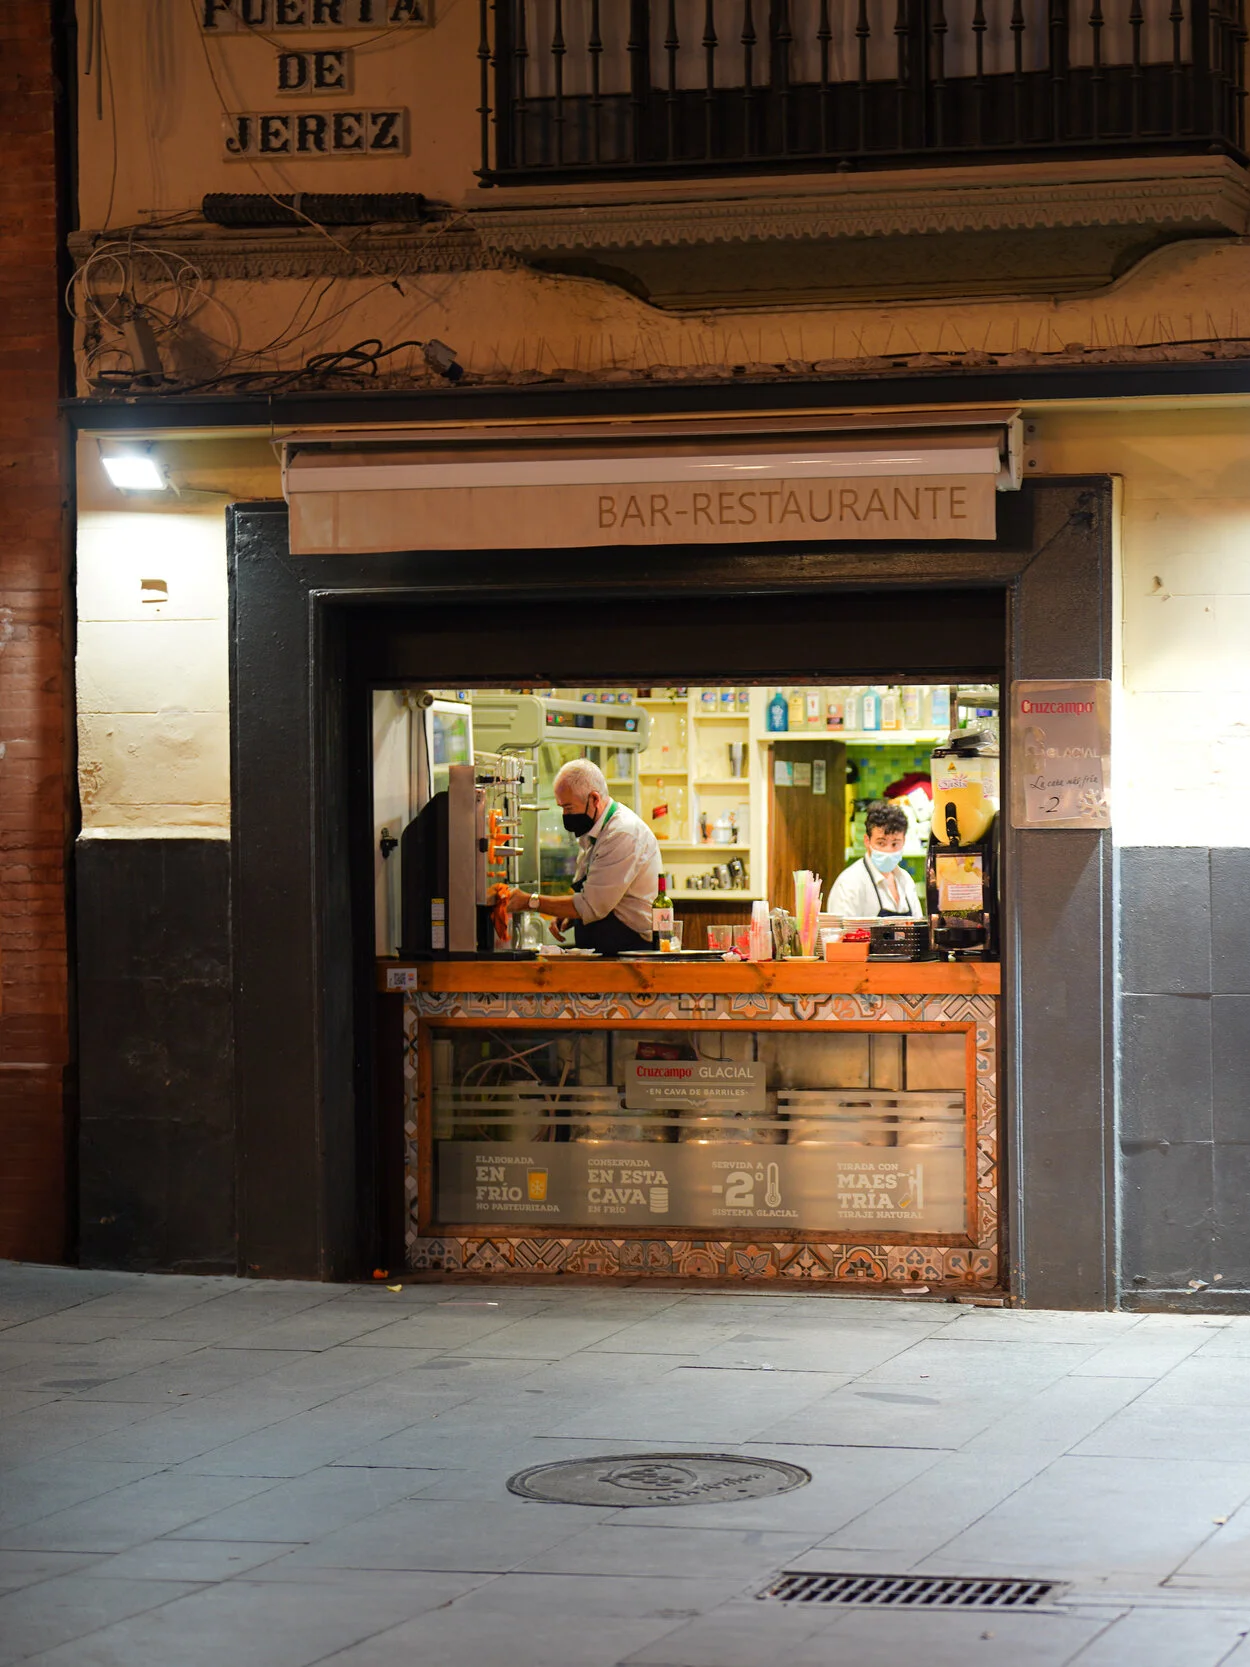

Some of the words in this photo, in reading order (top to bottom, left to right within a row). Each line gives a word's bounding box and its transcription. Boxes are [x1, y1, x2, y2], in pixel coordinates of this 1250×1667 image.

[277, 51, 344, 90] DE
[225, 112, 400, 154] JEREZ
[598, 486, 968, 529] BAR-RESTAURANTE
[1021, 699, 1094, 716] Cruzcampo
[636, 1066, 693, 1079] Cruzcampo
[699, 1067, 754, 1078] GLACIAL
[664, 1088, 686, 1096] CAVA
[689, 1088, 701, 1096] DE
[703, 1088, 745, 1096] BARRILES
[475, 1155, 534, 1165] ELABORADA
[587, 1158, 651, 1168] CONSERVADA
[711, 1161, 753, 1169] SERVIDA
[756, 1162, 764, 1170] A
[837, 1162, 875, 1171] TIRADA
[878, 1163, 899, 1171] CON
[475, 1166, 505, 1182] EN
[587, 1169, 614, 1184] EN
[620, 1169, 669, 1185] ESTA
[837, 1173, 898, 1190] MAES
[475, 1183, 522, 1201] FRÍO
[587, 1188, 648, 1205] CAVA
[837, 1189, 895, 1209] TRÍA
[476, 1203, 489, 1211] NO
[491, 1203, 560, 1213] PASTEURIZADA
[588, 1205, 601, 1213] EN
[712, 1208, 754, 1217] SISTEMA
[756, 1209, 799, 1218] GLACIAL
[837, 1211, 874, 1219] TIRAJE
[876, 1211, 924, 1219] NATURAL
